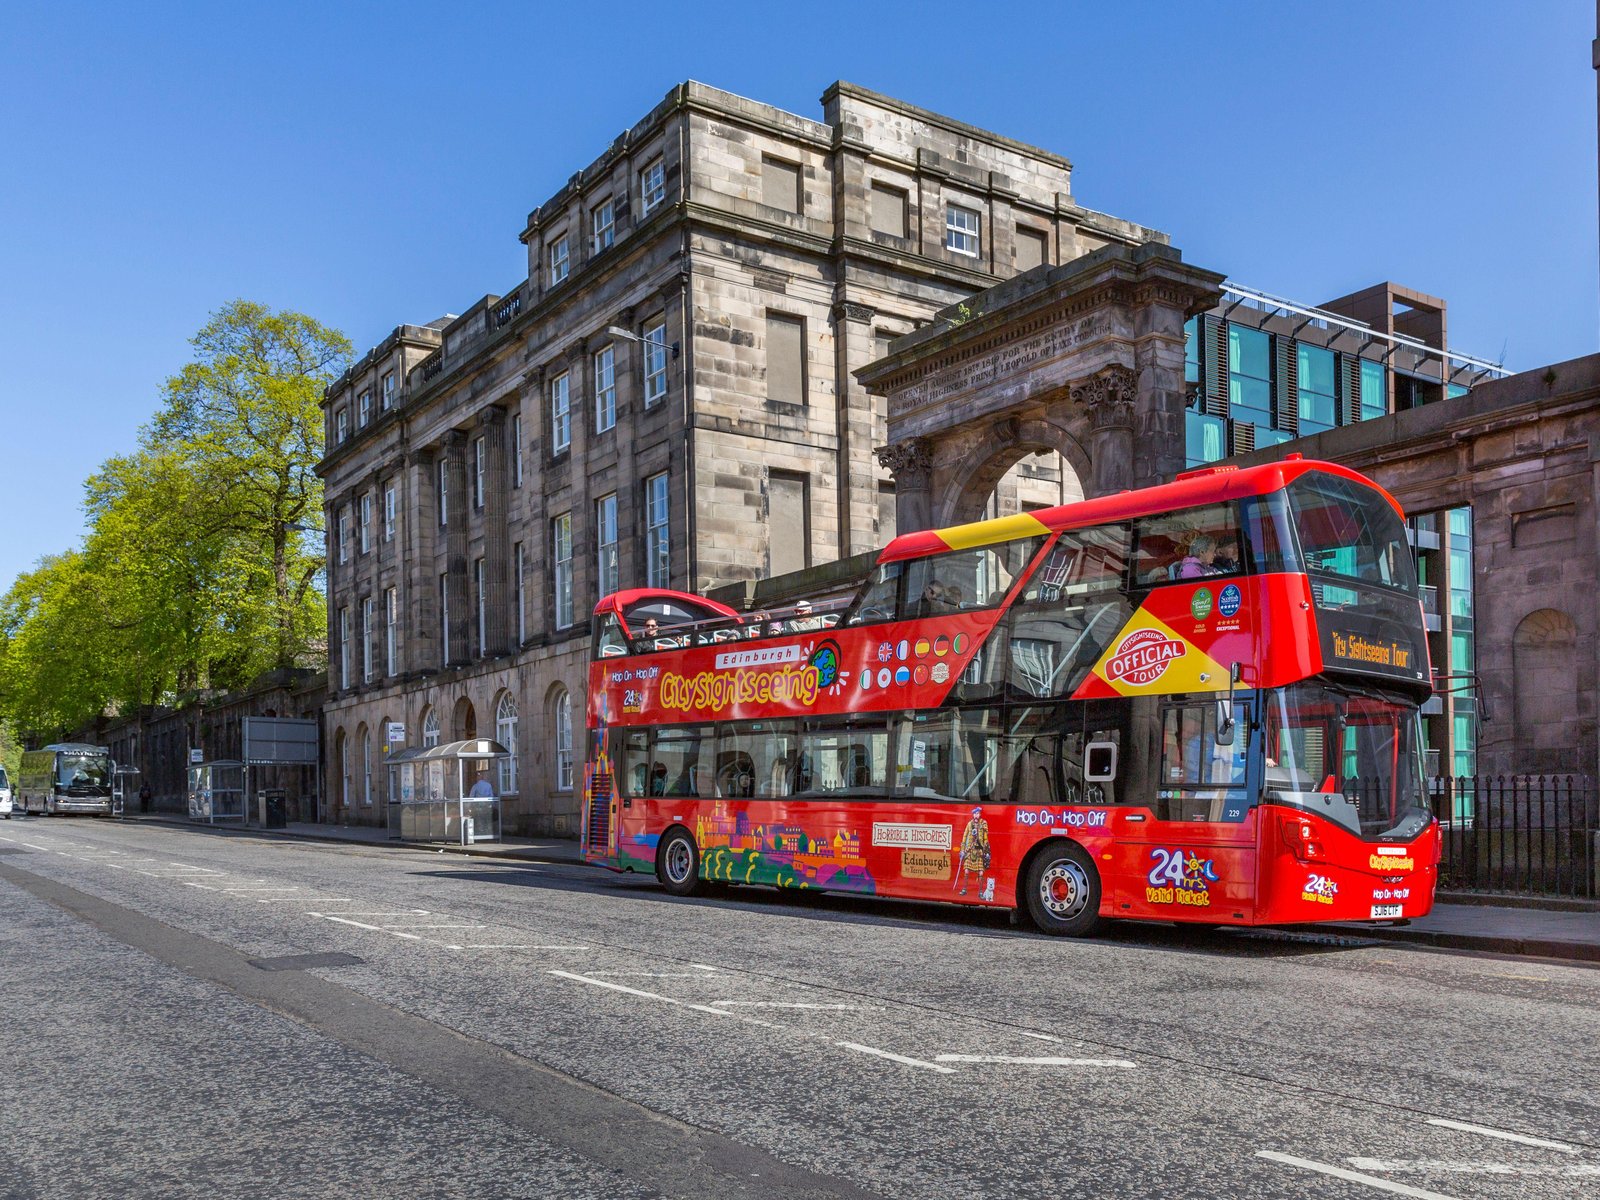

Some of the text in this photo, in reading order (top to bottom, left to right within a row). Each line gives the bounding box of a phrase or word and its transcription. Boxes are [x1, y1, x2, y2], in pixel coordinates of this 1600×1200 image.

[931, 370, 961, 388] AUGUST
[1003, 346, 1020, 359] FOR
[1023, 339, 1041, 352] THE
[1044, 324, 1077, 344] ENTRY
[1081, 316, 1095, 329] OF
[902, 396, 927, 410] ROYAL
[929, 379, 968, 400] HIGHNESS
[971, 368, 998, 384] PRINCE
[1001, 352, 1037, 372] LEOPOLD
[1040, 346, 1051, 357] OF
[1074, 323, 1112, 342] COBOURG
[1121, 632, 1163, 651] CITYSIGHTSEEING
[723, 648, 792, 664] Edinburgh
[1112, 642, 1181, 675] OFFICIAL
[1348, 635, 1389, 664] Sightseeing
[1392, 643, 1408, 668] Tour
[612, 667, 659, 682] Hop On Hop Off
[1133, 664, 1165, 682] TOUR
[660, 664, 819, 712] CitySightseeing
[624, 690, 634, 705] 24
[1016, 810, 1106, 827] Hop On Hop Off
[1228, 809, 1240, 817] 229
[877, 828, 947, 843] HORRIBLE HISTORIES
[903, 852, 949, 870] Edinburgh
[1149, 848, 1184, 886] 24
[909, 867, 923, 875] Terry
[923, 868, 938, 876] Deary
[1304, 873, 1325, 894] 24
[1146, 887, 1210, 906] Valid Ticket
[1373, 888, 1410, 899] Hop On Hop Off
[1388, 905, 1399, 916] CTF
